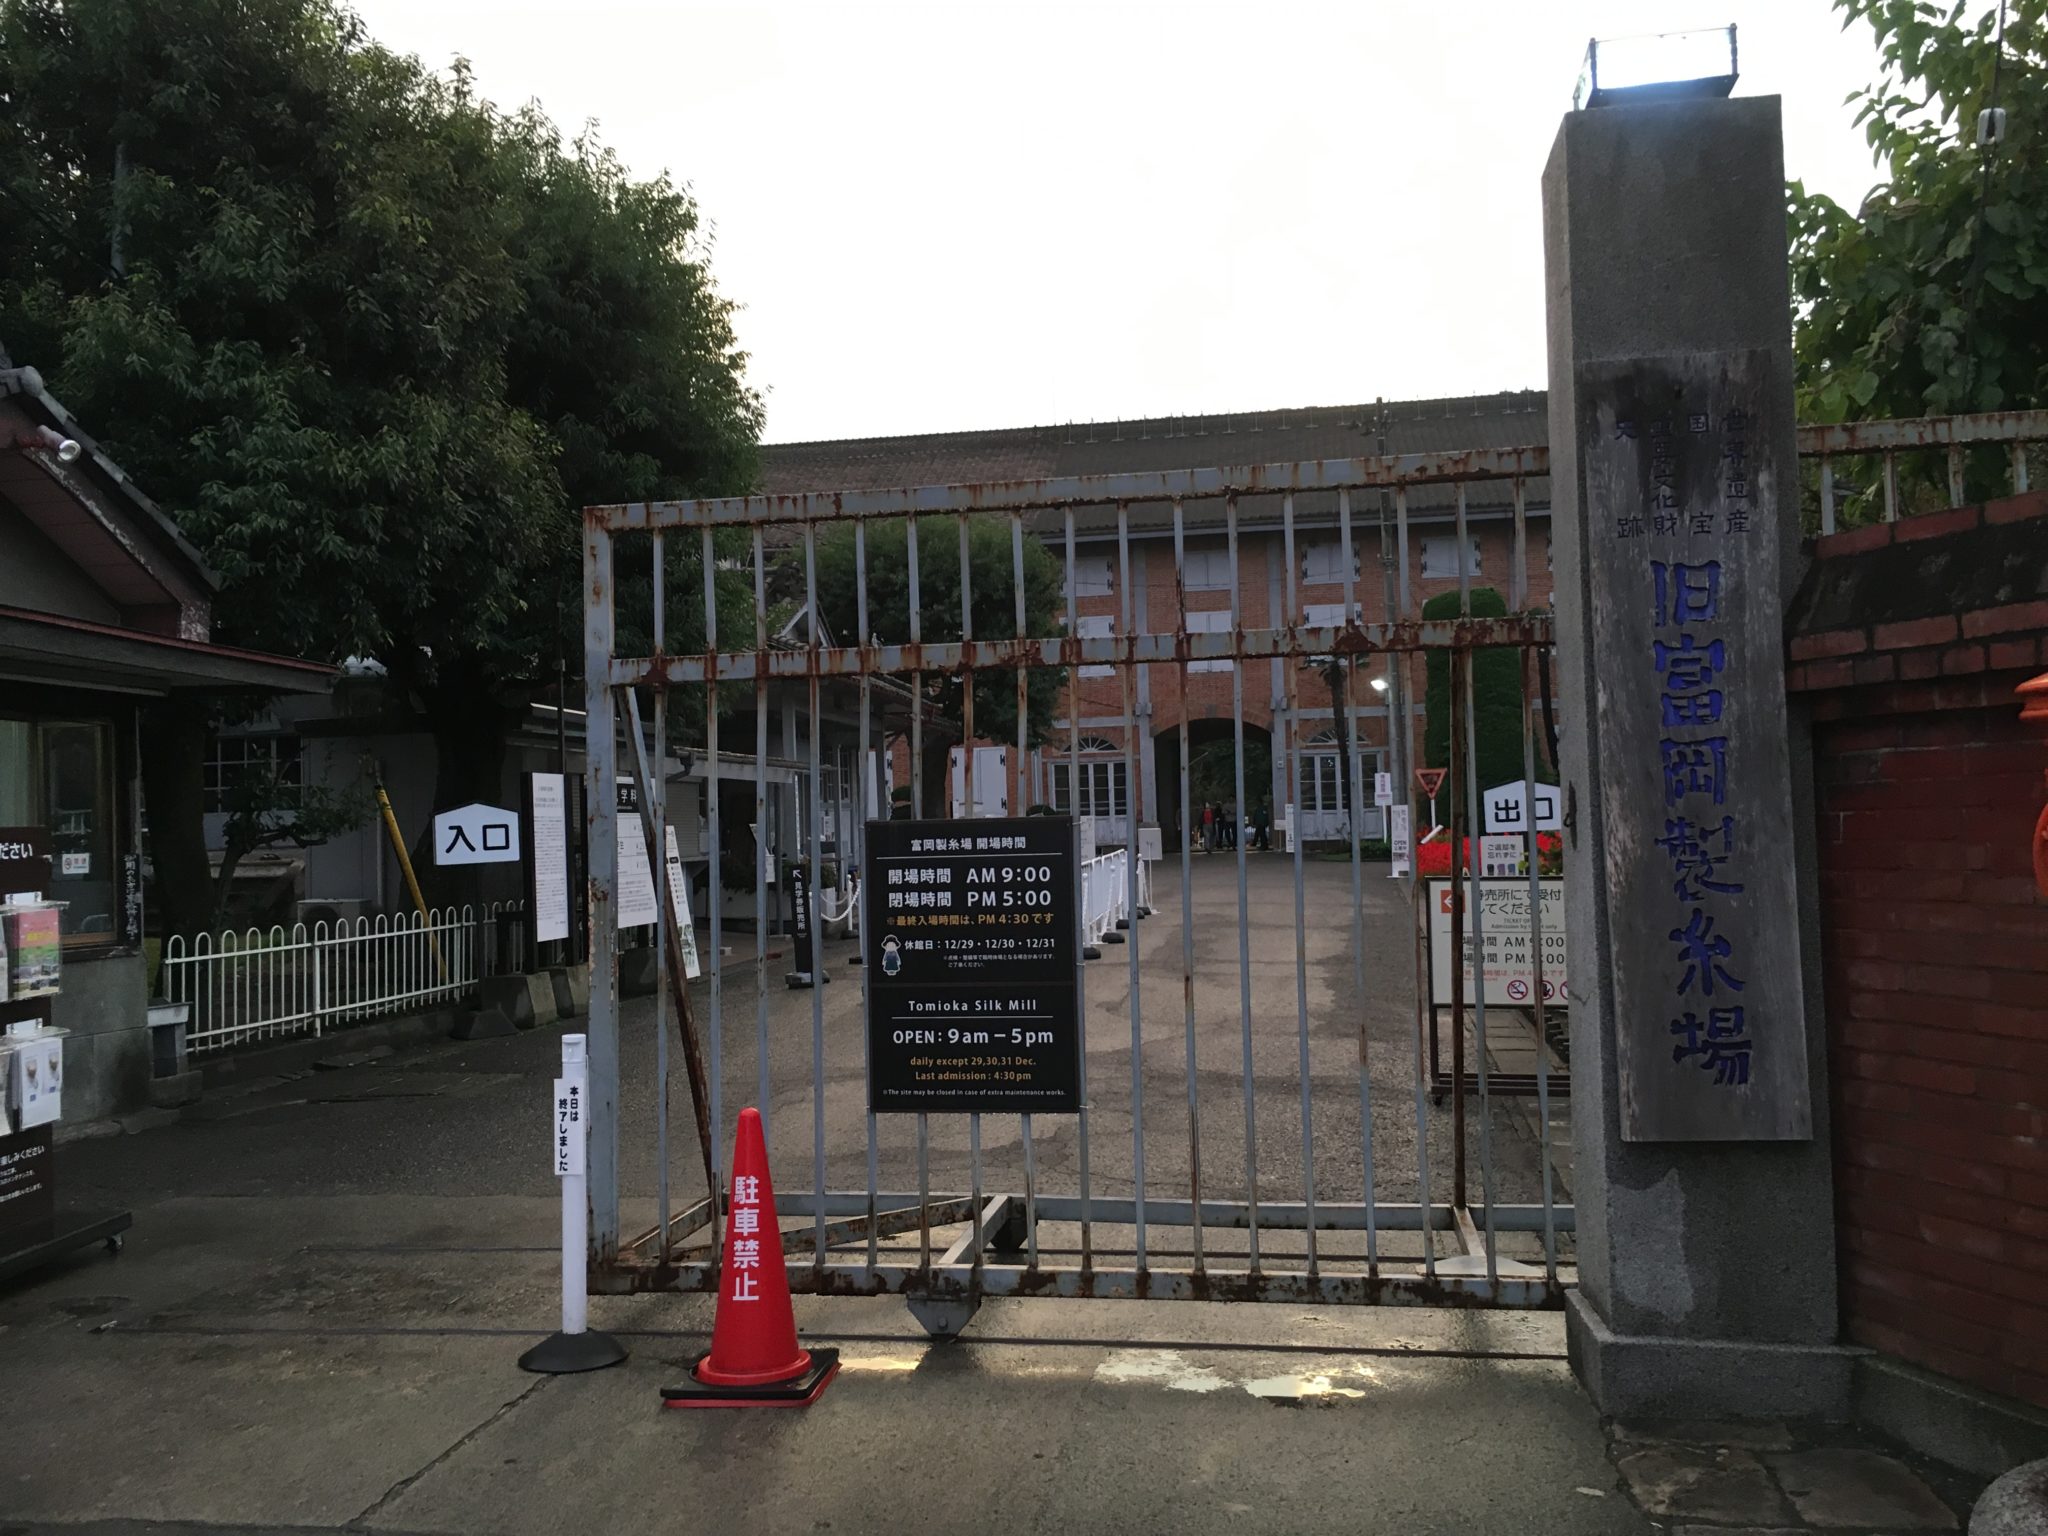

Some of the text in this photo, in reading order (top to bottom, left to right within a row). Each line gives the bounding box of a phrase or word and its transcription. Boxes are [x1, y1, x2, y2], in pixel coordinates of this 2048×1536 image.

[1494, 798, 1553, 822] 出口
[1650, 560, 1752, 1085] 旧富岡製糸場
[445, 824, 509, 853] 入口
[911, 836, 1026, 851] 富岡製糸場 開場時間
[888, 866, 1051, 884] 開場時間 AM 9:00
[889, 890, 1052, 908] 閉場時間 PM 5:00
[908, 999, 1037, 1011] Tomioka Silk Mill
[910, 1057, 934, 1067] daily
[936, 1057, 968, 1067] except
[1015, 1056, 1037, 1066] Dec.
[915, 1071, 935, 1081] Last
[570, 1086, 579, 1122] 本日は
[559, 1098, 568, 1171] 終了しました
[732, 1176, 760, 1301] 駐車禁止
